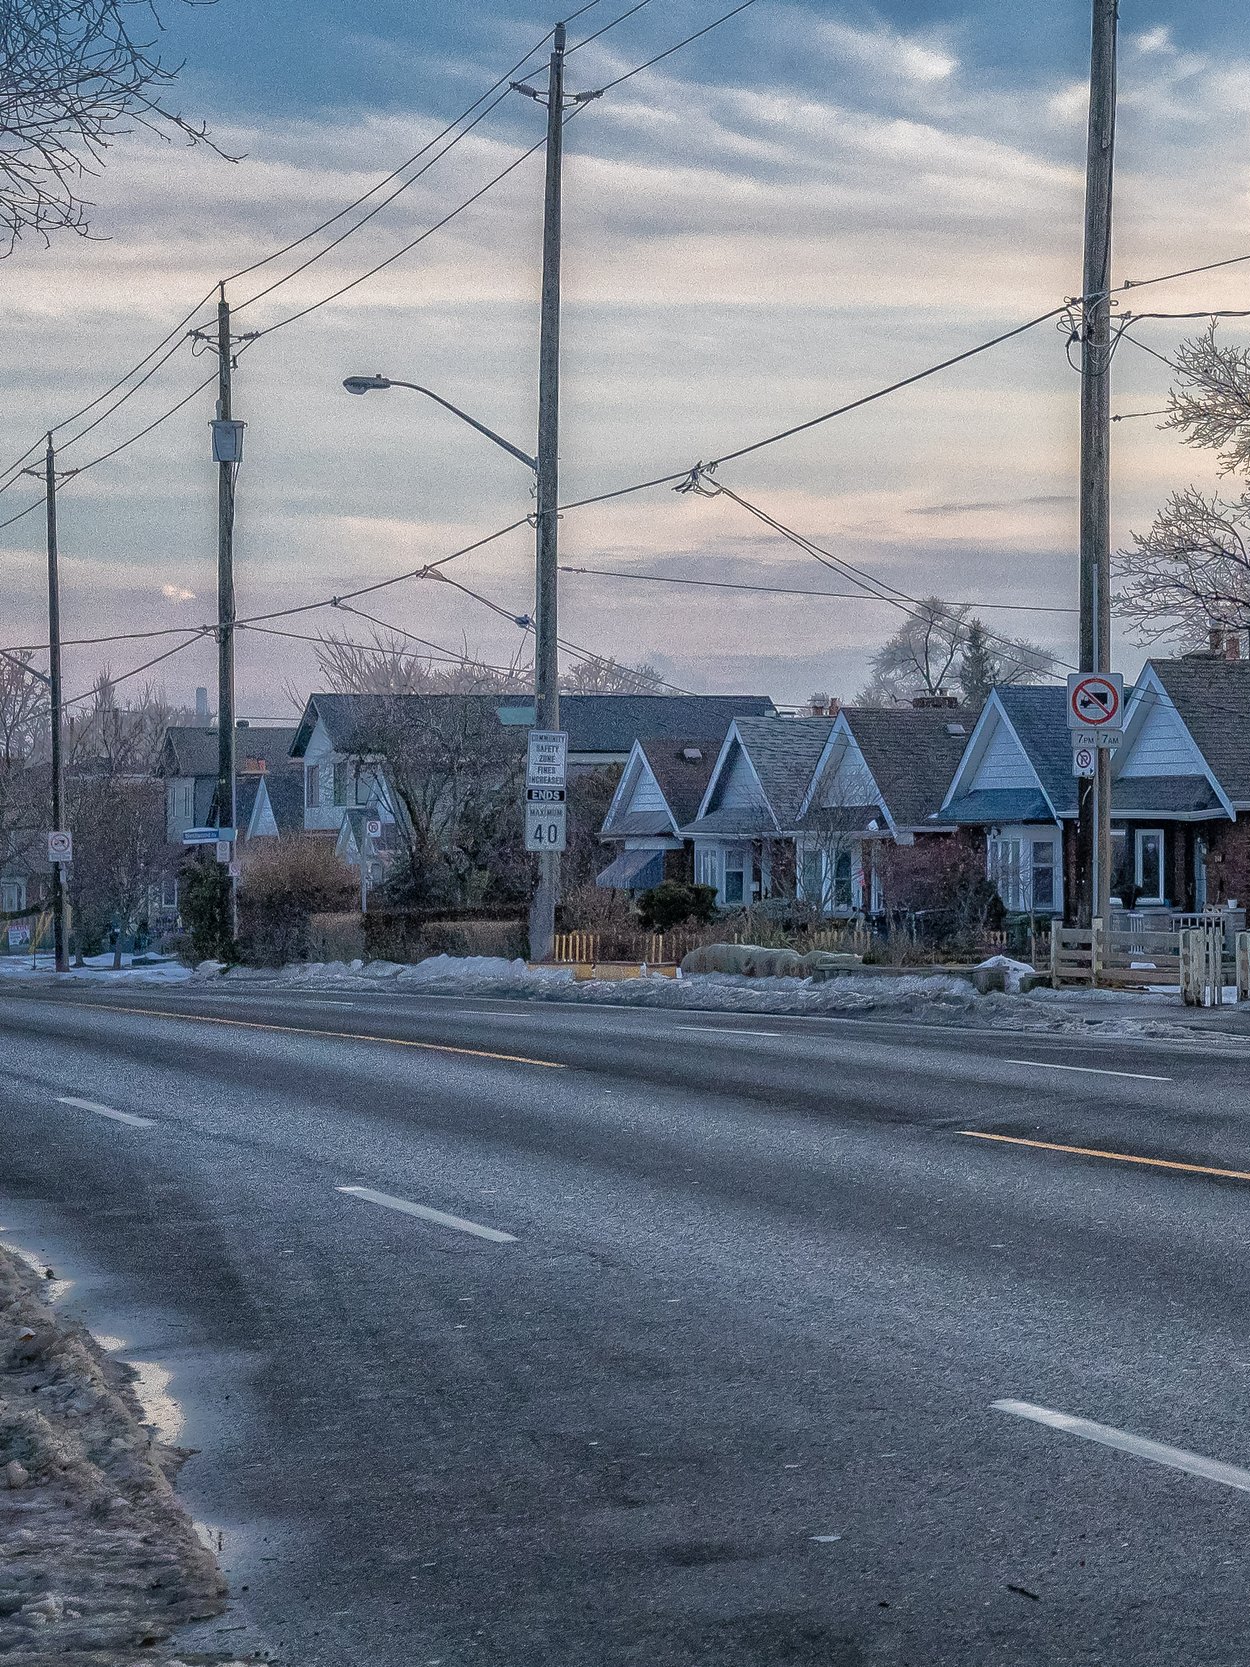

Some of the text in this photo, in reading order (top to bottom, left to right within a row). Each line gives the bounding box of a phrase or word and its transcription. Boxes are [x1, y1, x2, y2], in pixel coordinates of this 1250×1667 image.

[537, 766, 556, 774] FINES
[529, 776, 564, 784] INCREASED
[532, 790, 560, 800] ENDS
[534, 824, 557, 843] 40
